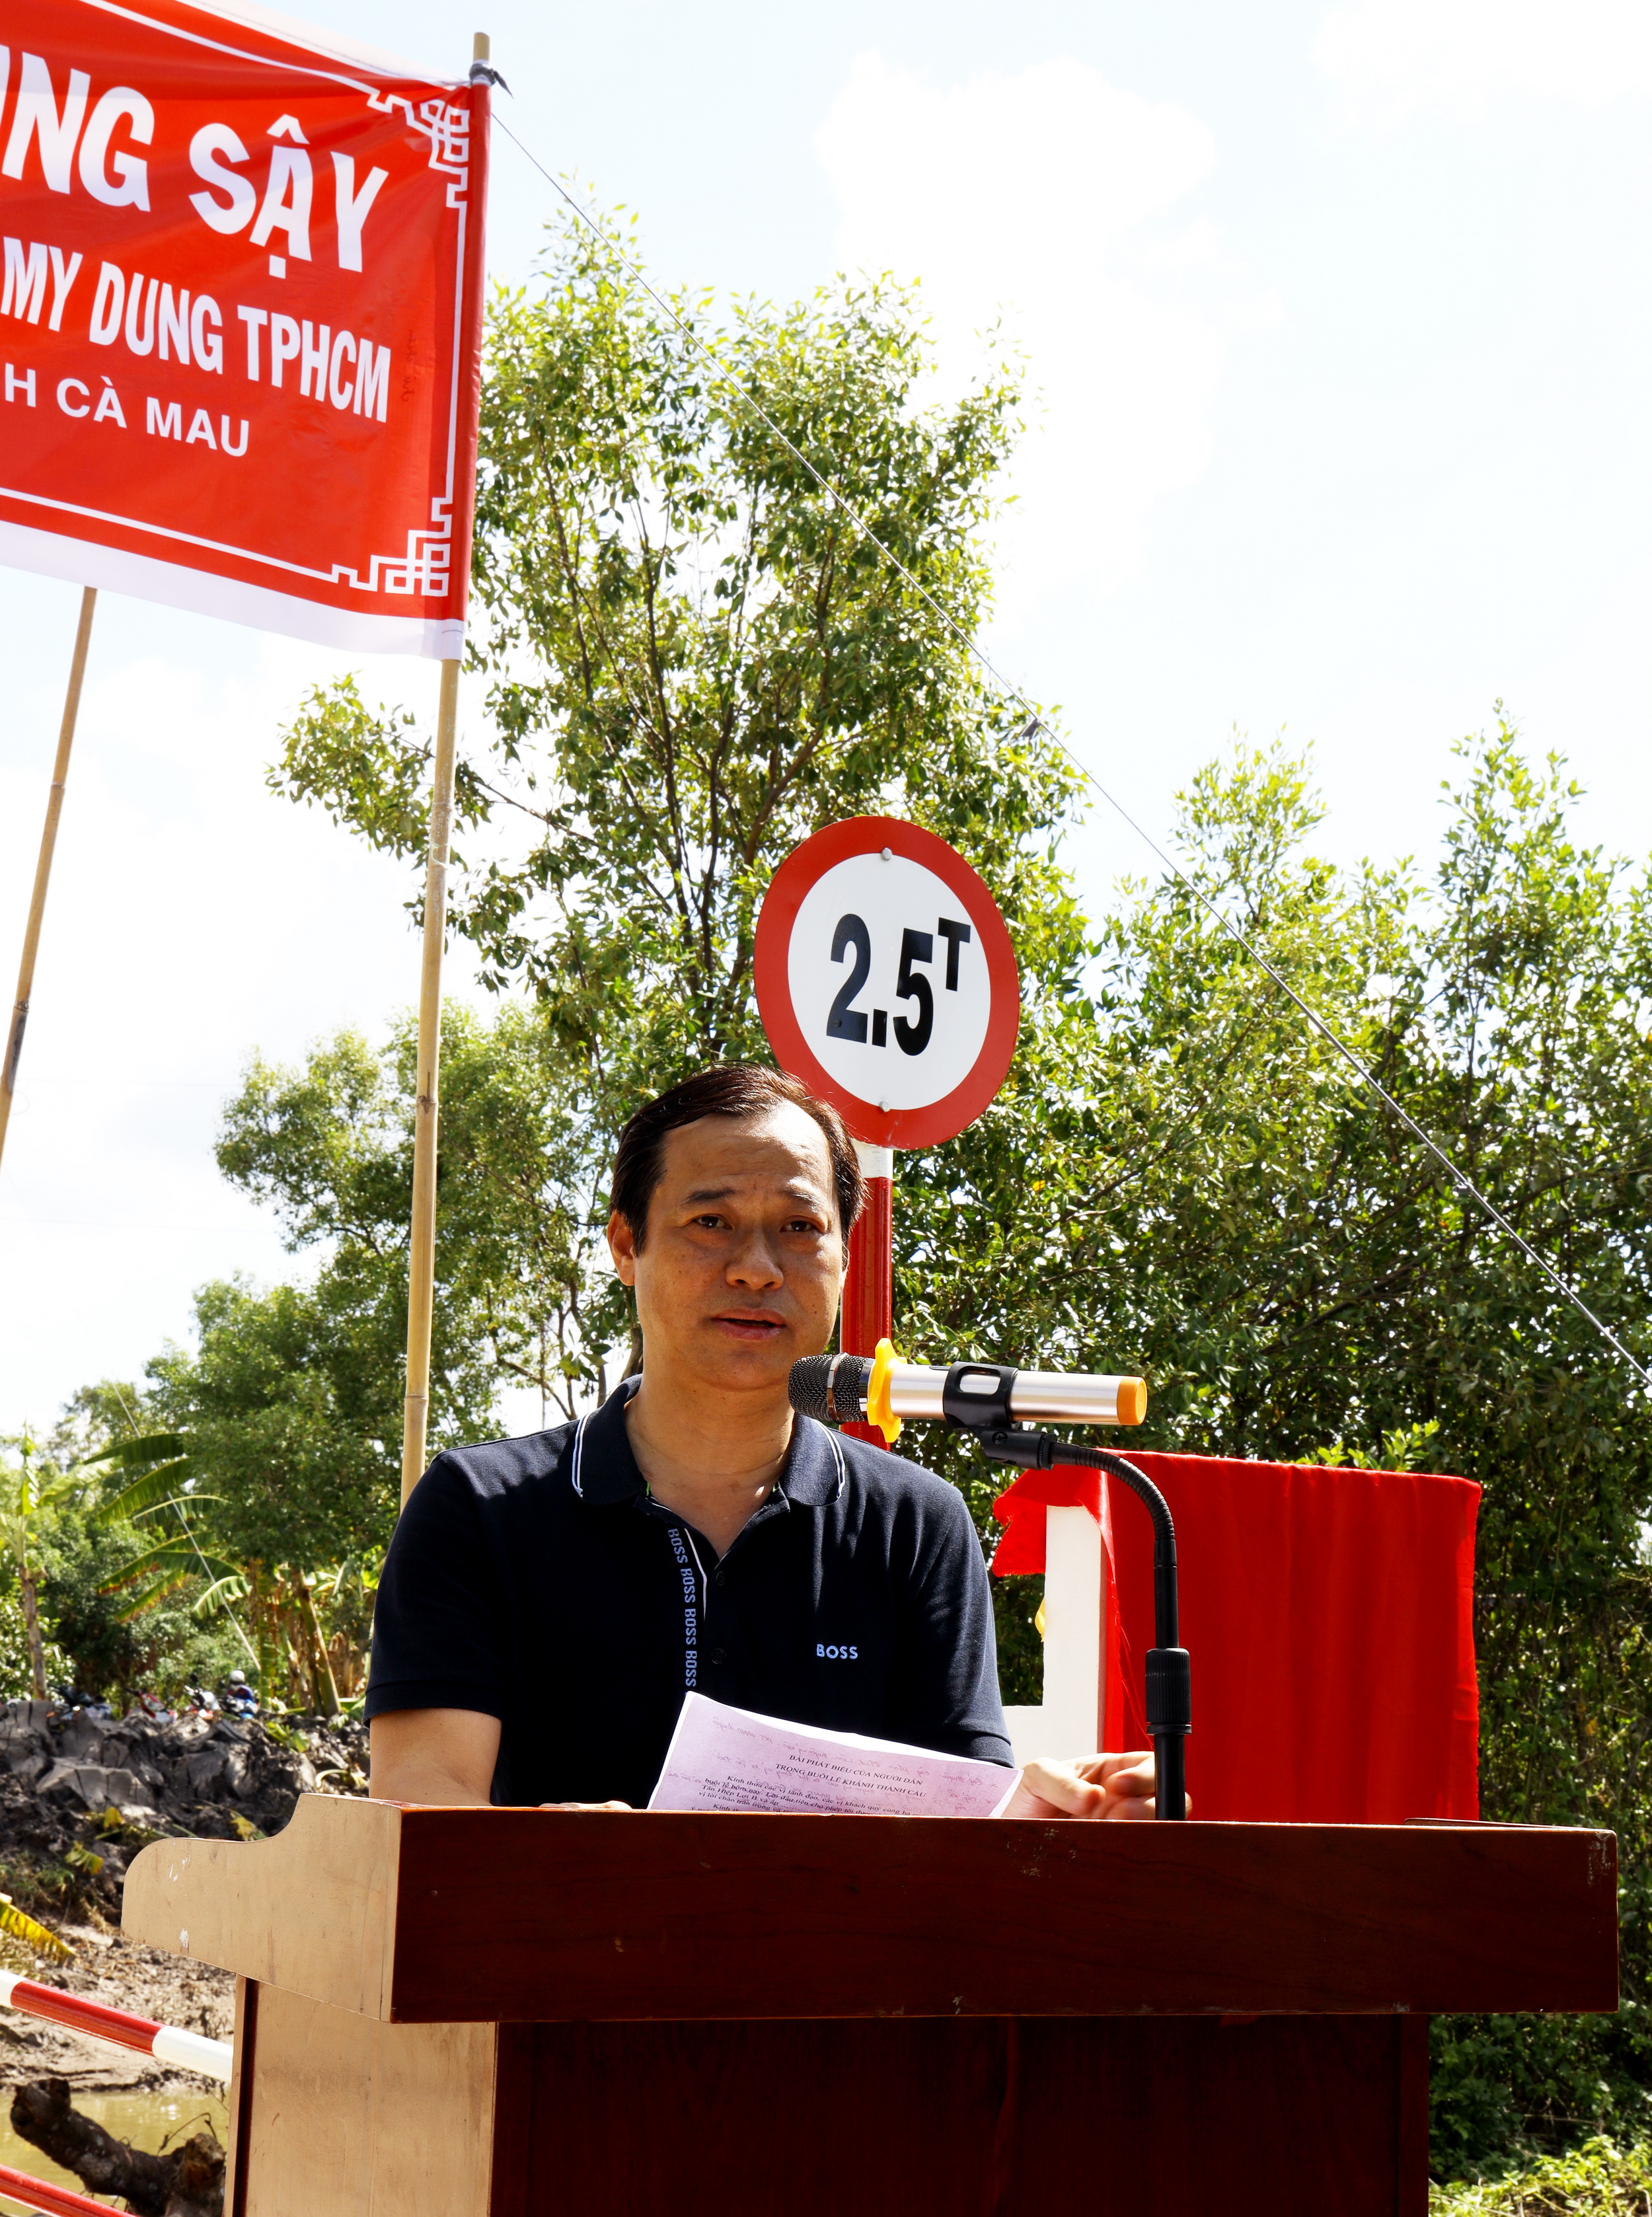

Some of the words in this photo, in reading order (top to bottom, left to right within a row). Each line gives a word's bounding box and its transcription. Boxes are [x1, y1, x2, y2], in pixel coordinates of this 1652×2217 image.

[0, 44, 155, 212] NG
[189, 114, 389, 279] SẬY
[0, 237, 83, 332] MY
[89, 261, 223, 375] DUNG
[237, 305, 391, 423] TPHCM
[5, 363, 36, 408] H
[57, 375, 127, 428] CÀ
[147, 396, 249, 457] MAU
[667, 1528, 688, 1563] BOSS
[680, 1568, 696, 1603] BOSS
[685, 1608, 696, 1645] BOSS
[685, 1651, 697, 1686] BOSS
[816, 1643, 858, 1659] BOSS
[727, 1776, 745, 1784] Kính
[776, 1763, 806, 1775] TRONG
[842, 1779, 875, 1789] KHÁNH
[876, 1784, 907, 1793] THÀNH
[806, 1759, 831, 1769] PHÁT
